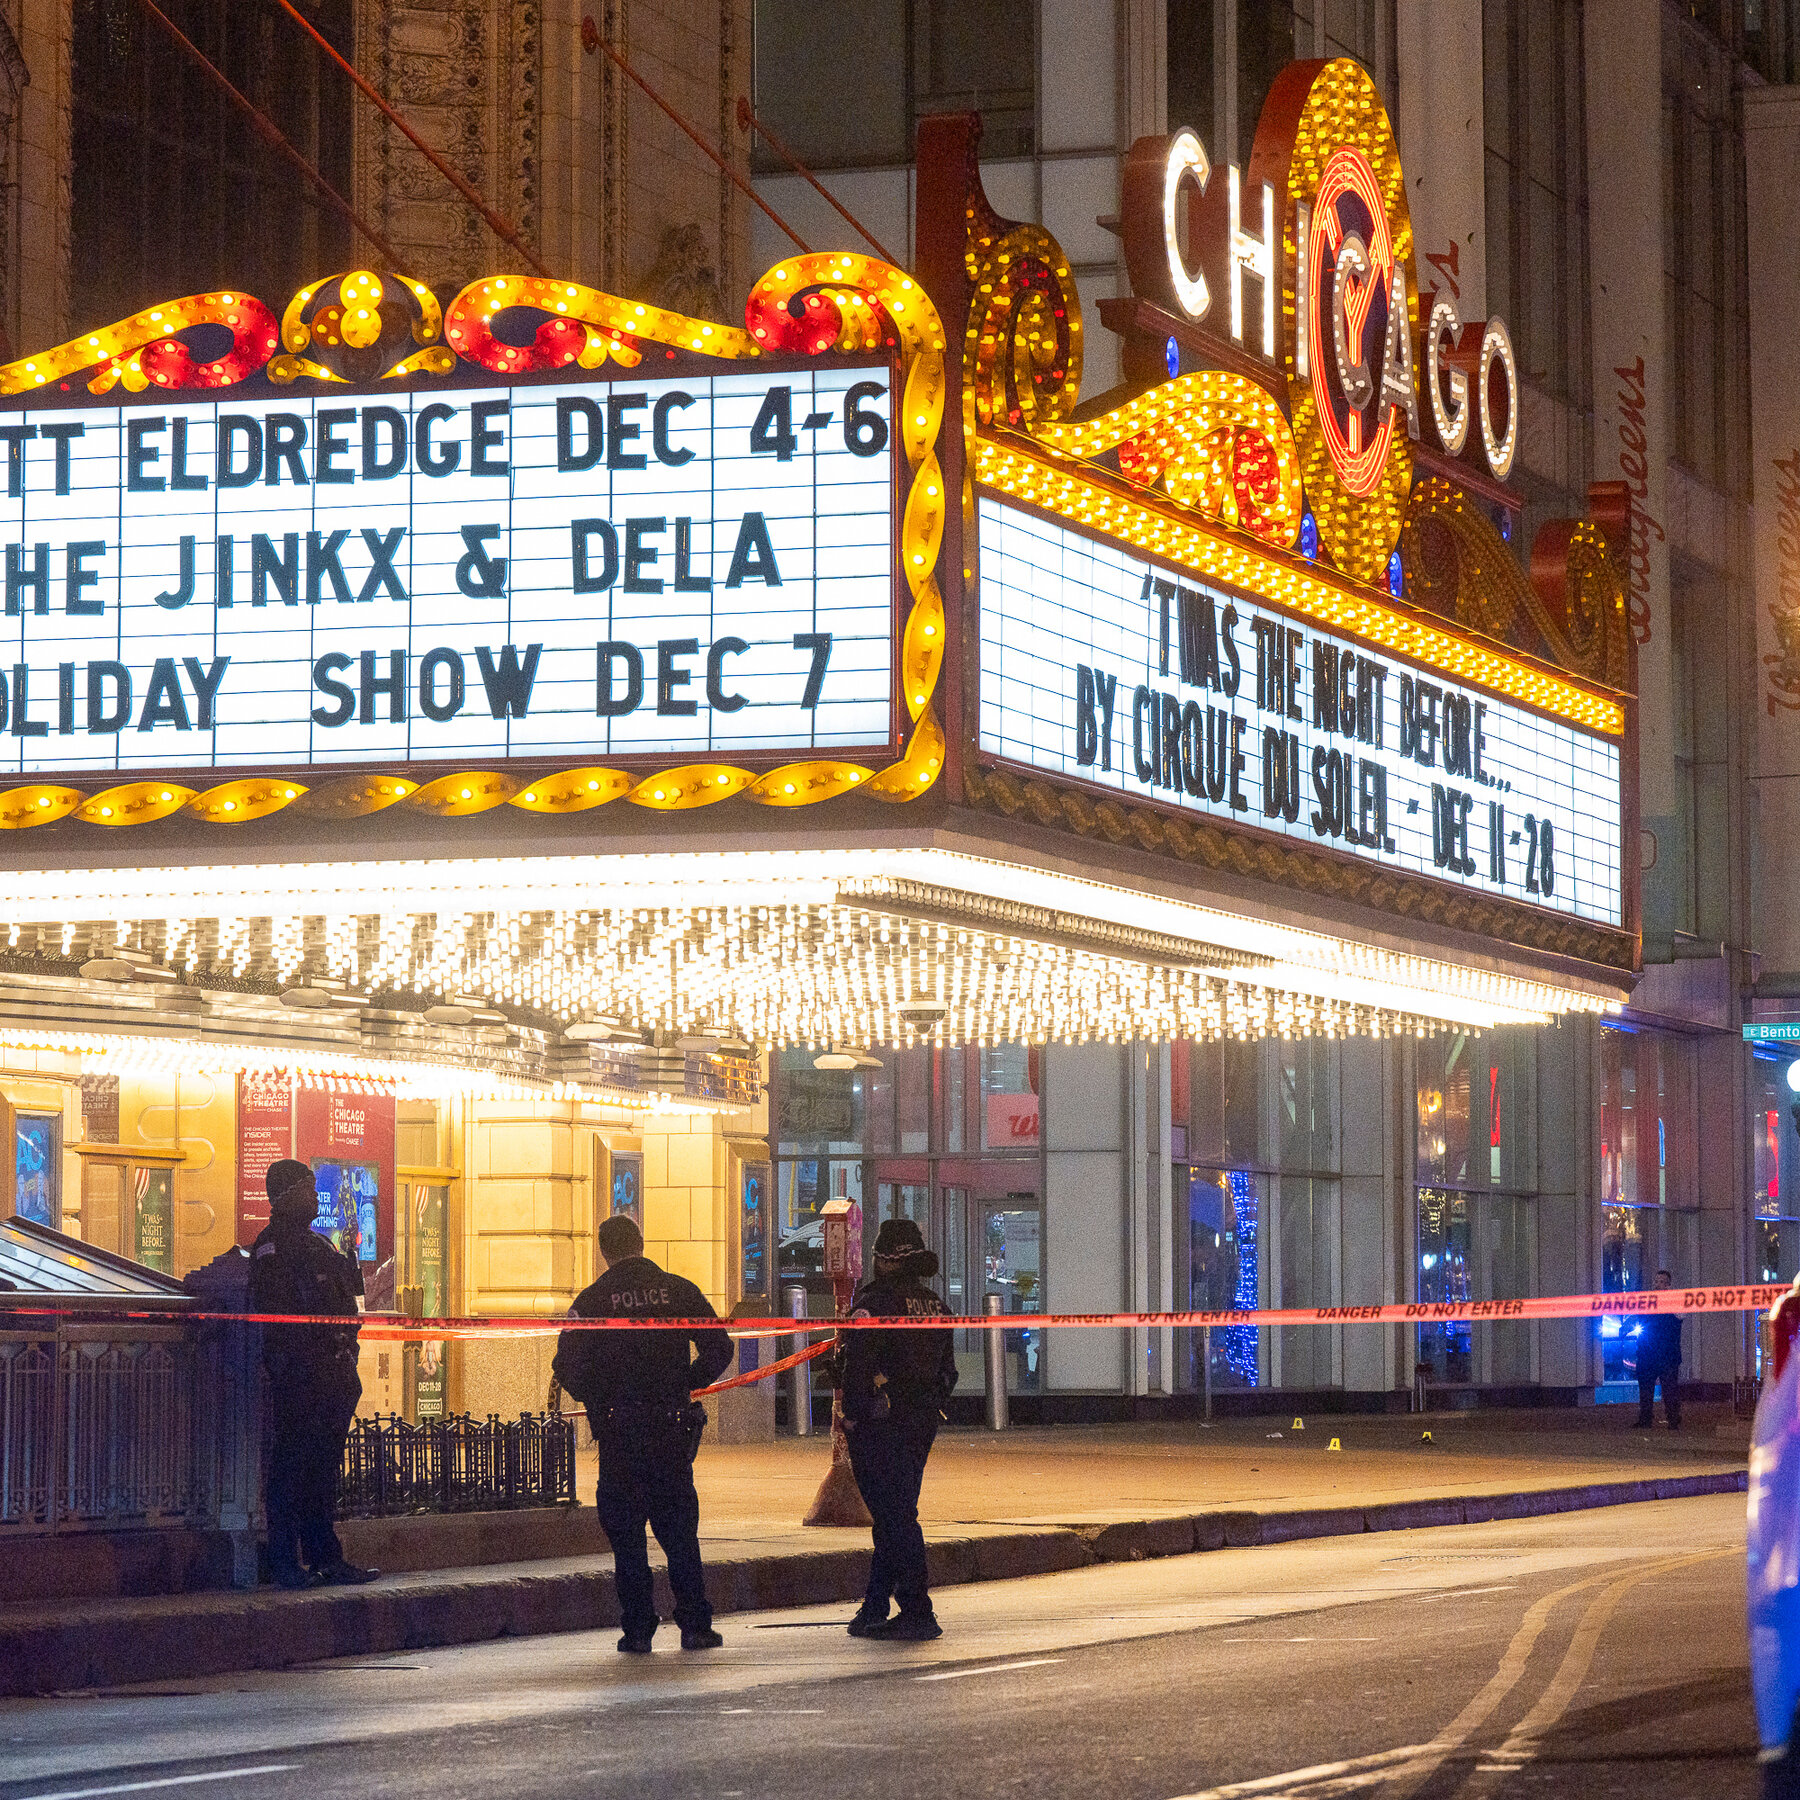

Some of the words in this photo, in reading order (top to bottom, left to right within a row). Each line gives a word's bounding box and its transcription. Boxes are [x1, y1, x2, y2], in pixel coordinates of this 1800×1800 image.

[1163, 126, 1519, 482] CHICAGO
[127, 399, 511, 493] ELDREDGE
[556, 391, 697, 473] DEC
[750, 381, 889, 463] 4-6
[5, 540, 106, 616] HE
[154, 527, 410, 610] JINKX
[455, 523, 508, 600] &
[571, 512, 783, 595] DELA
[0, 656, 231, 737] LIDAY
[310, 643, 544, 728] SHOW
[596, 636, 750, 717] DEC
[793, 633, 833, 710] 7
[1250, 614, 1304, 724] THE
[1312, 638, 1389, 751] NIGHT
[1076, 663, 1118, 772] BY
[1133, 684, 1248, 813] CIRQUE
[1263, 724, 1301, 824] DU
[1311, 745, 1396, 854] SOLEIL
[1431, 782, 1477, 877] DEC
[1489, 800, 1554, 898] 11-28
[1761, 1026, 1800, 1038] Bento
[335, 1099, 344, 1107] THE
[334, 1108, 365, 1122] CHICAGO
[334, 1121, 365, 1135] THEATRE
[345, 1137, 360, 1146] CHASE
[311, 1216, 338, 1228] NOTHING
[141, 1225, 163, 1236] NIGHT
[611, 1288, 670, 1310] POLICE
[905, 1297, 944, 1317] POLICE
[1591, 1295, 1658, 1311] DANGER
[1683, 1292, 1706, 1308] DO
[1711, 1290, 1746, 1306] NOT
[1137, 1313, 1160, 1323] DO
[1163, 1312, 1194, 1322] NOT
[1200, 1310, 1250, 1322] ENTER
[1316, 1306, 1382, 1319] DANGER
[1405, 1304, 1428, 1316] DO
[1433, 1303, 1467, 1316] NOT
[1471, 1301, 1524, 1315] ENTER
[418, 1381, 430, 1392] DEC
[419, 1402, 441, 1411] CHICAGO
